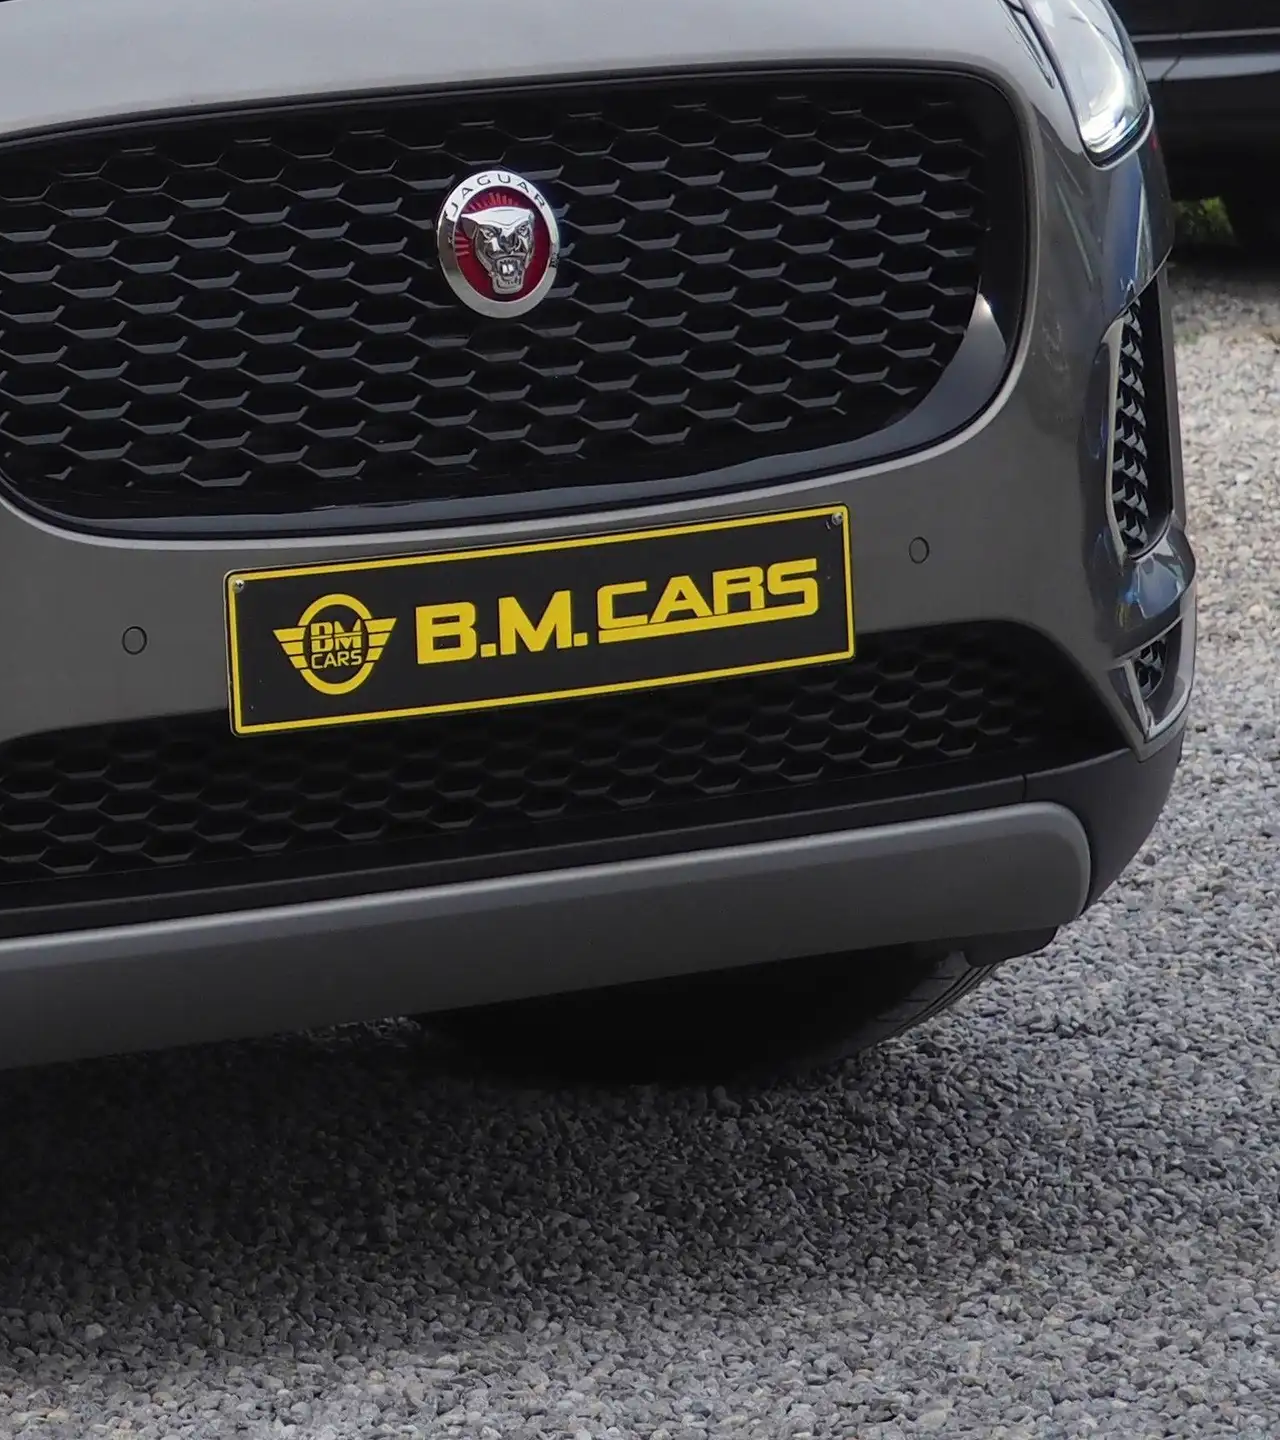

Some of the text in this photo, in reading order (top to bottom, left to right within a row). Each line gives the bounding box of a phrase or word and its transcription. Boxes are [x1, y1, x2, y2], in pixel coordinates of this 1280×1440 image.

[450, 173, 547, 219] JAGUAR
[310, 618, 363, 653] BM
[311, 649, 363, 670] CARS
